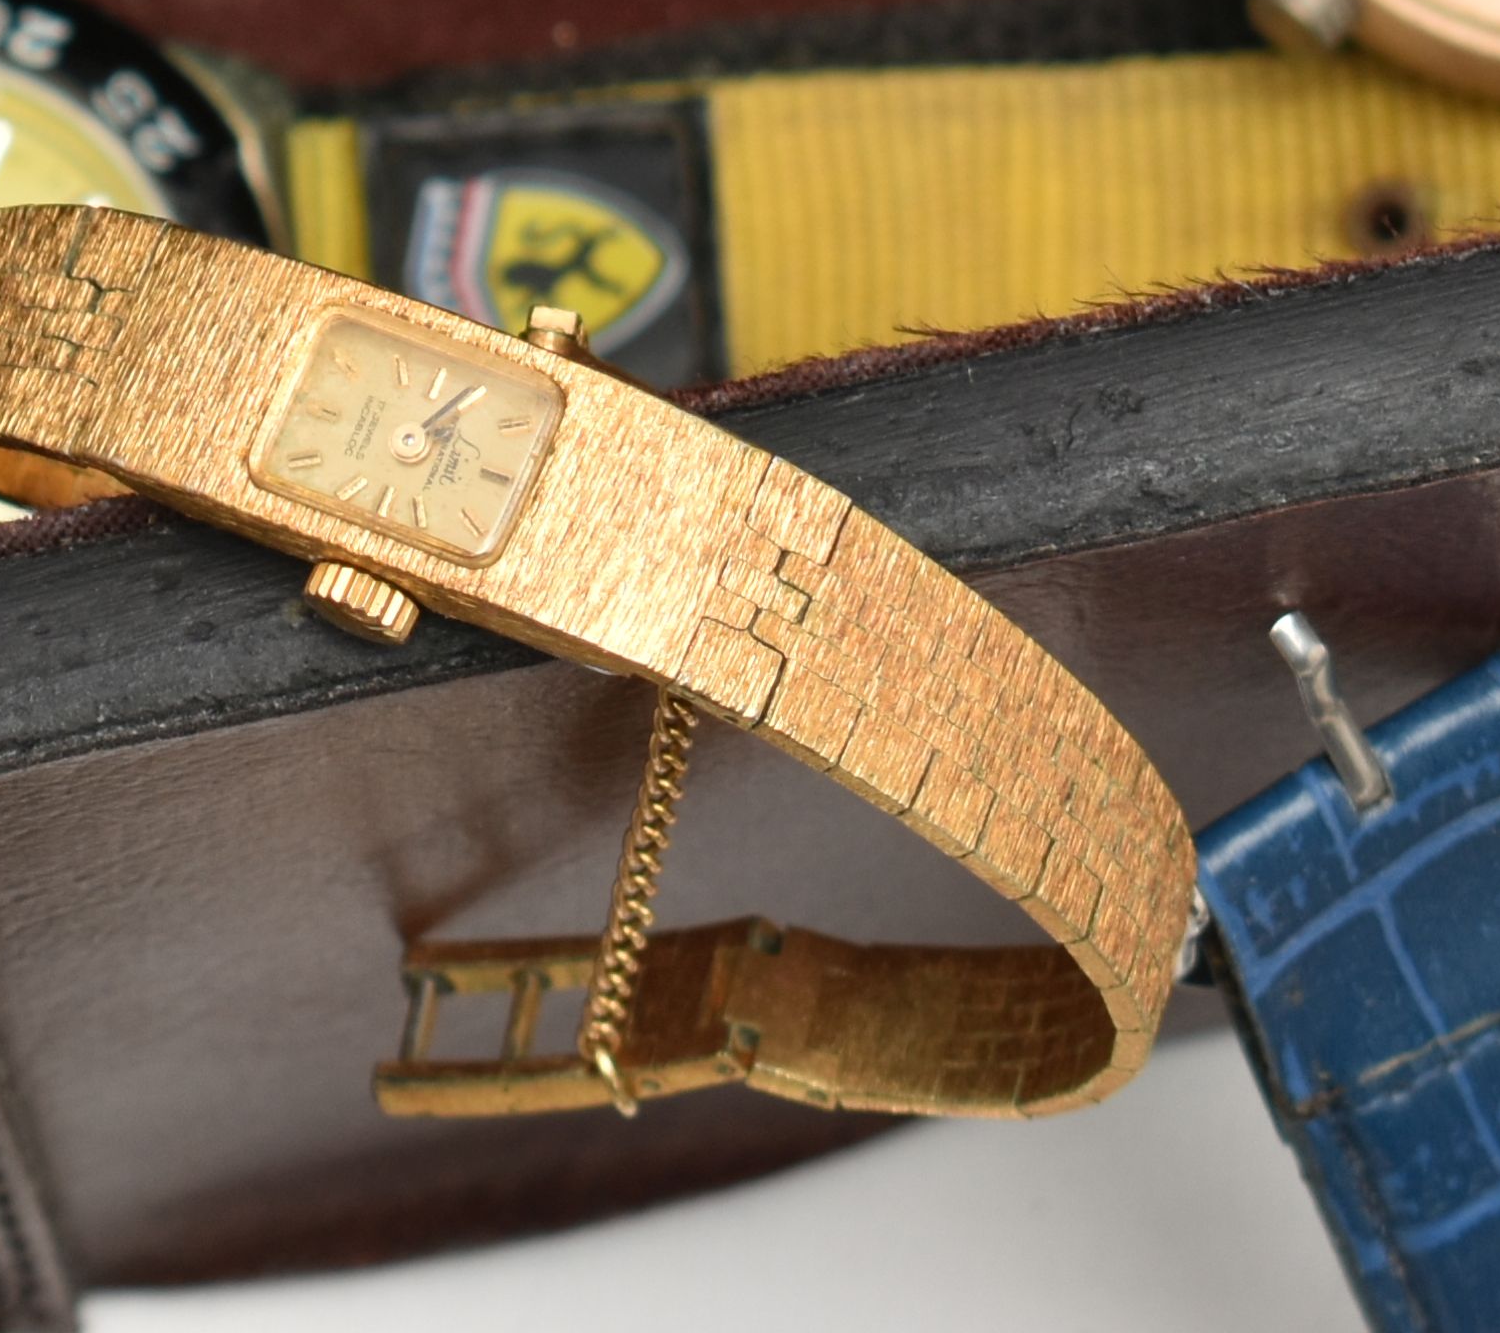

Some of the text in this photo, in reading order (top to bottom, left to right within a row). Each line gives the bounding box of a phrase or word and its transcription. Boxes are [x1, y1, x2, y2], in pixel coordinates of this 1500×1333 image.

[344, 395, 374, 458] INCABLOC
[356, 412, 382, 460] JEWELS
[439, 428, 482, 487] Limit
